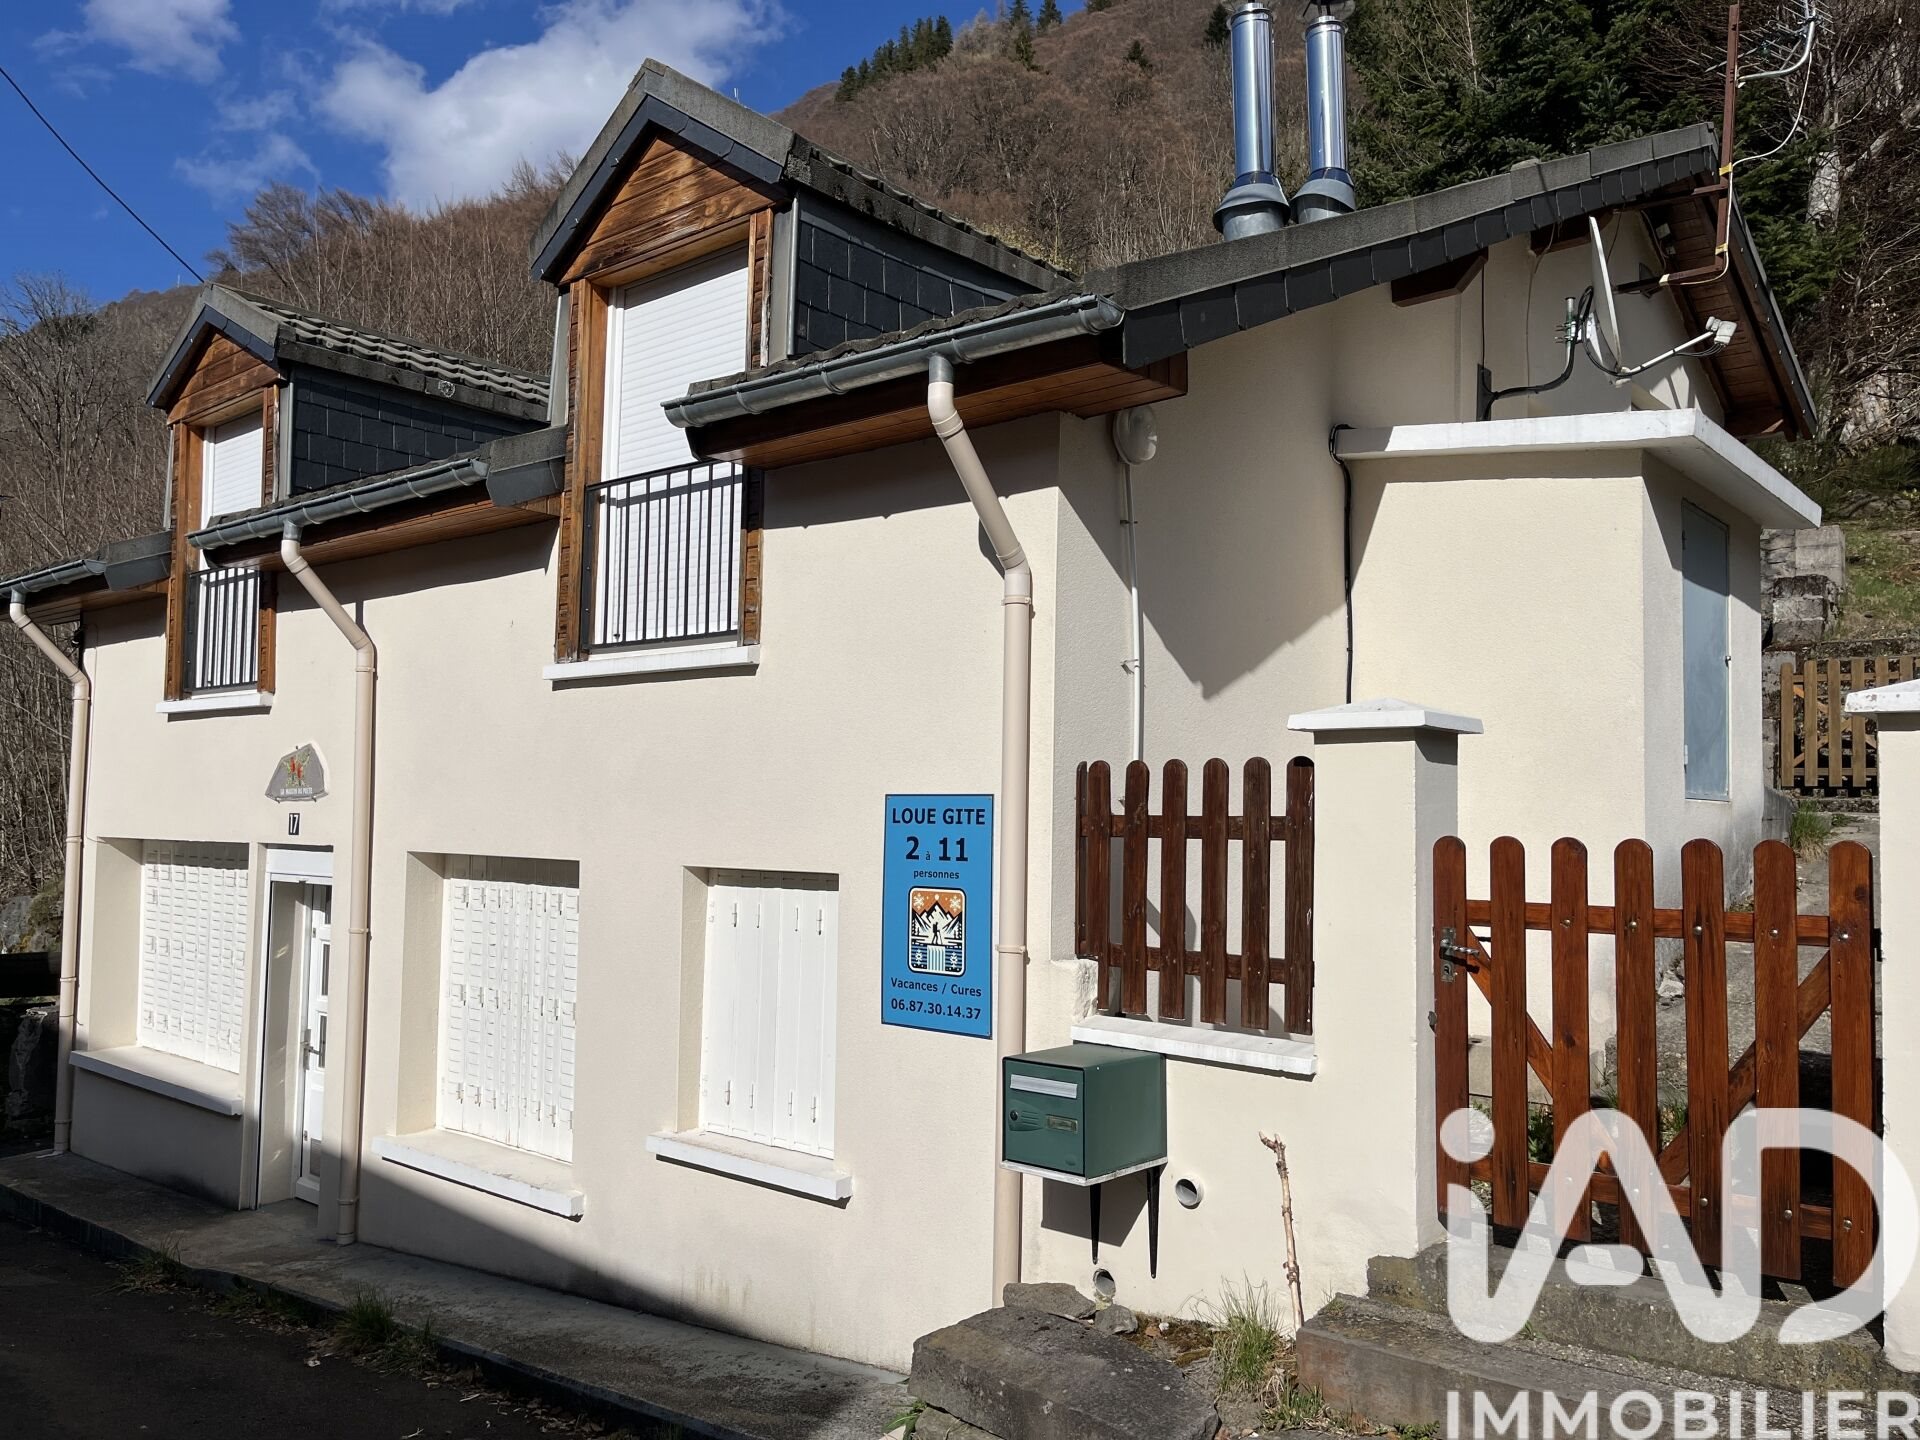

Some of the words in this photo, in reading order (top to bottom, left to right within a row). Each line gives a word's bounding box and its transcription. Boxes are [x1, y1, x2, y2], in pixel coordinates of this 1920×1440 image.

[289, 814, 299, 834] 17
[892, 808, 936, 824] LOUE
[943, 808, 985, 825] GITE
[905, 836, 919, 860] 2
[925, 851, 931, 861] à
[939, 837, 968, 862] 11
[913, 870, 960, 879] personnes
[891, 977, 938, 992] Vacances
[941, 983, 947, 994] /
[951, 984, 982, 997] Cures
[891, 998, 981, 1020] 06.87.30.14.37
